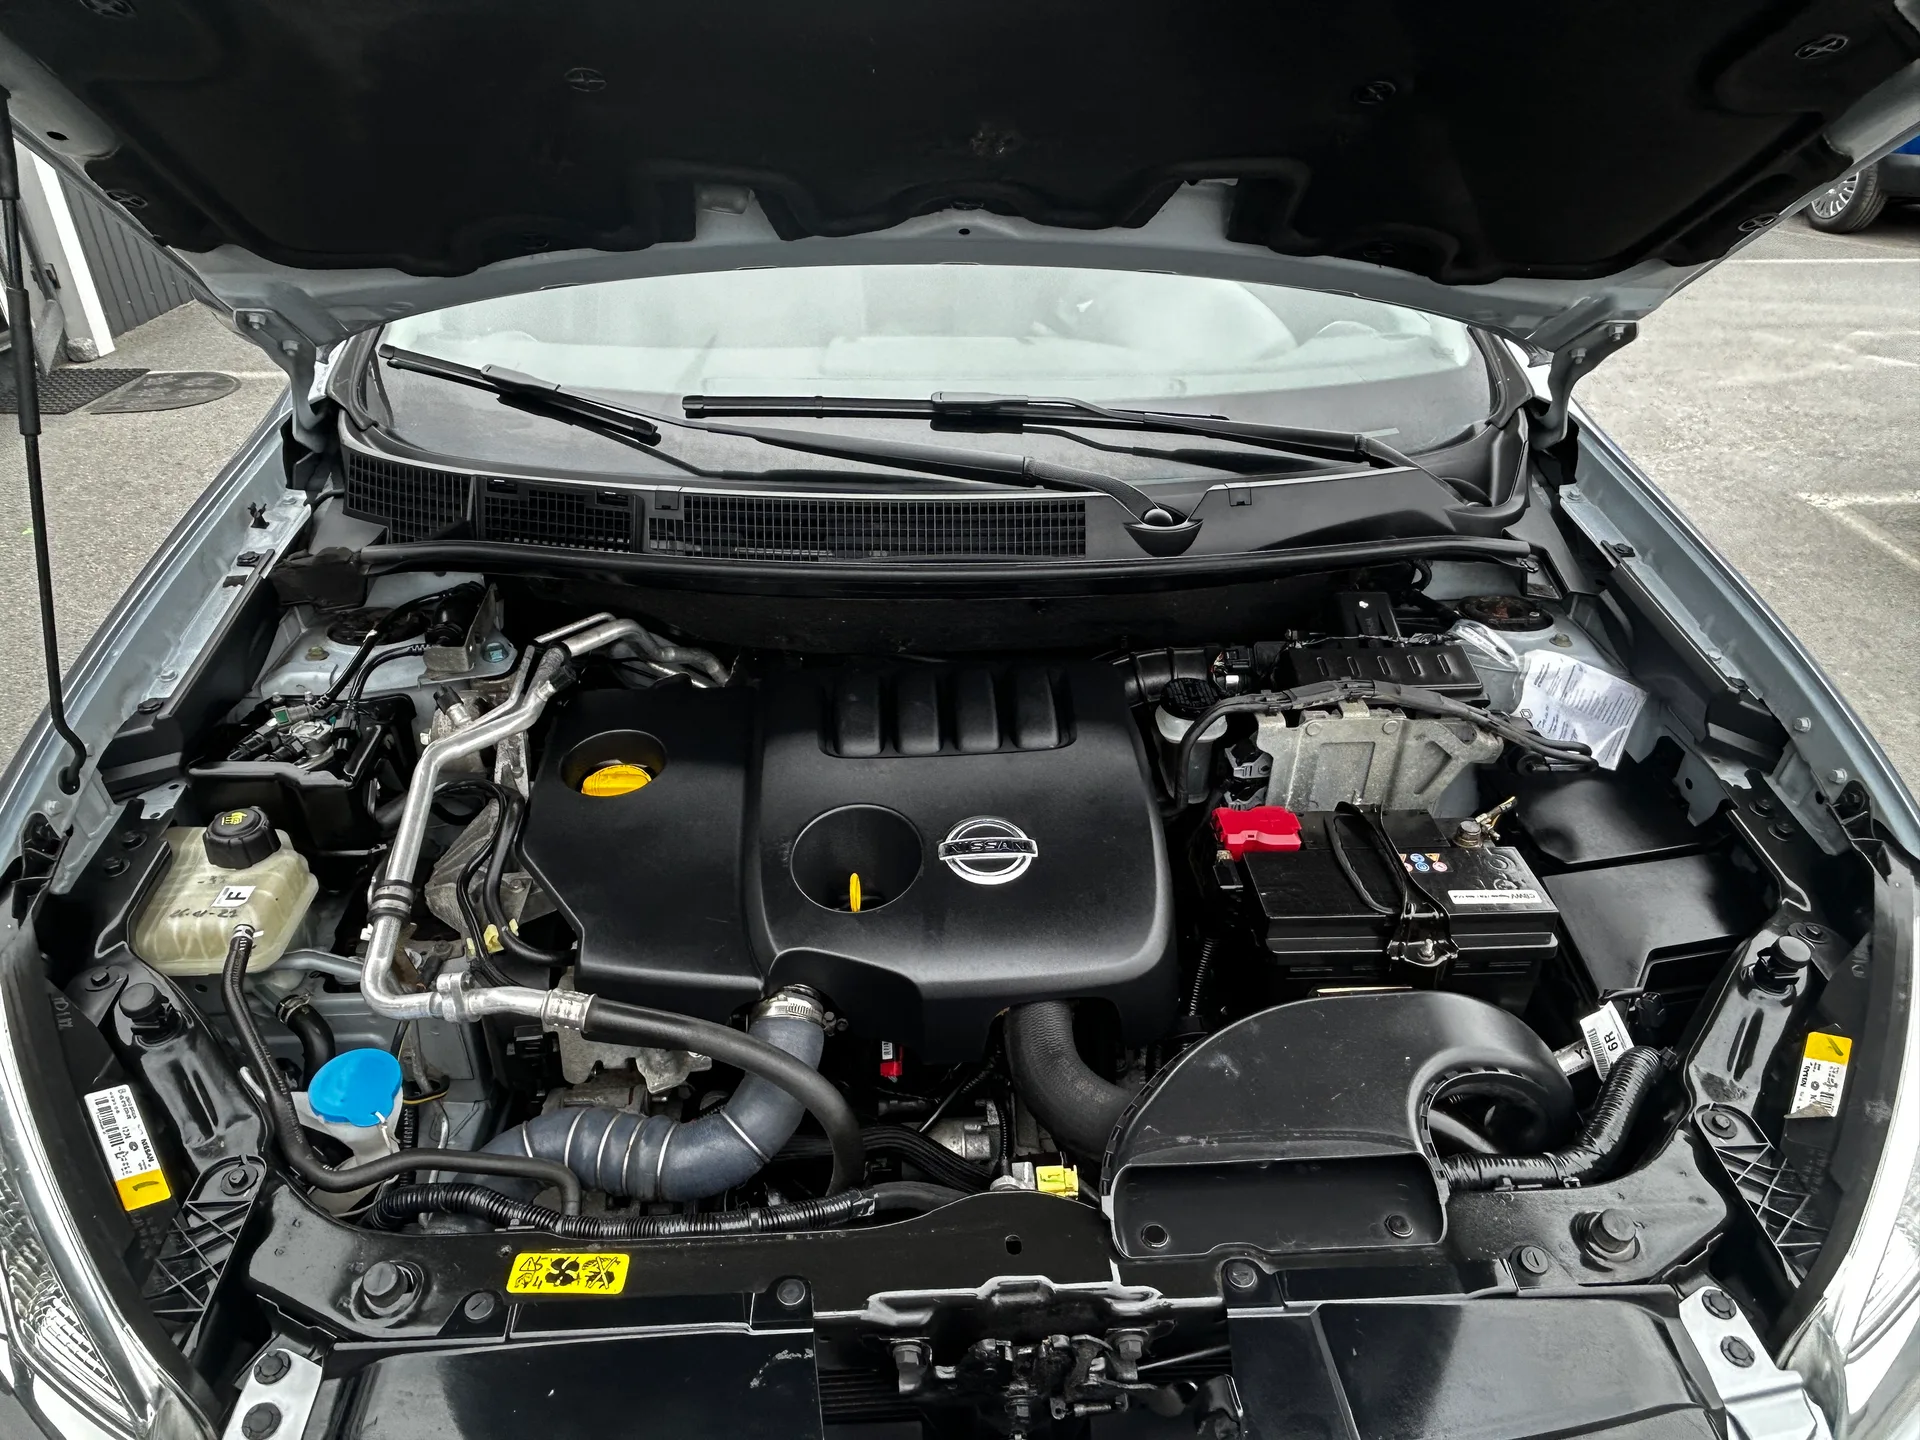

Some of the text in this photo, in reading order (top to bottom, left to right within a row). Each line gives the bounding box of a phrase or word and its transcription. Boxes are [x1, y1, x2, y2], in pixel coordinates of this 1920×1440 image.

[945, 840, 1030, 854] NISSAN
[225, 891, 247, 901] F
[1604, 1030, 1619, 1052] 6R
